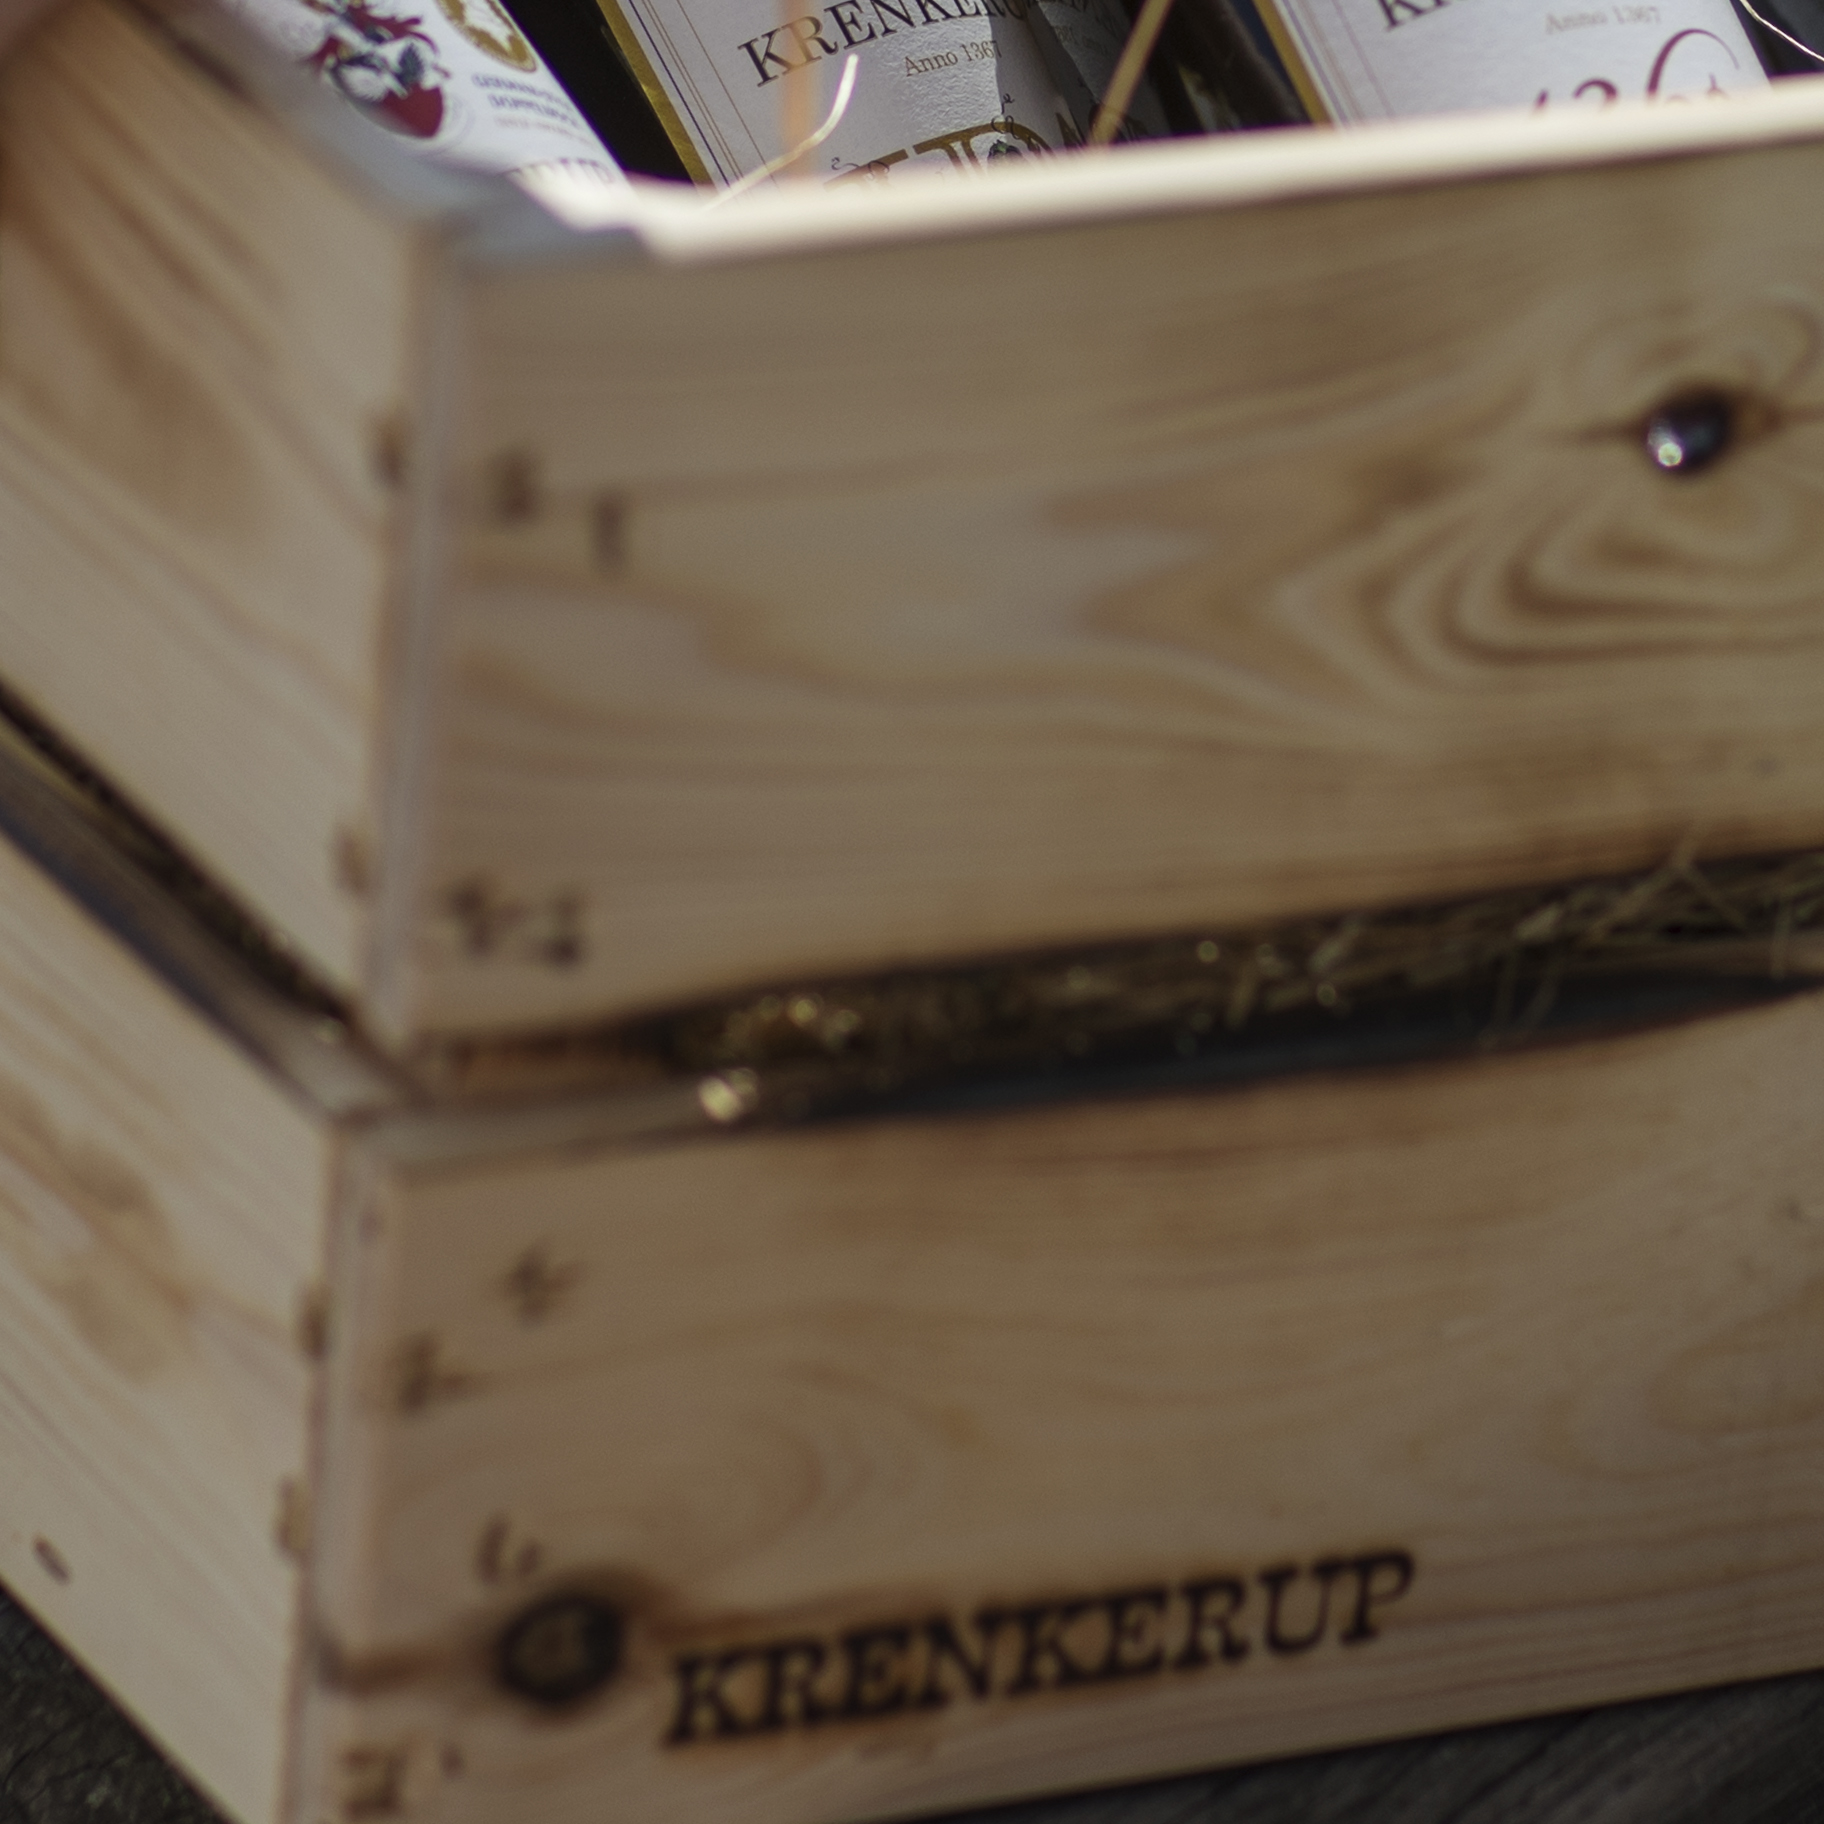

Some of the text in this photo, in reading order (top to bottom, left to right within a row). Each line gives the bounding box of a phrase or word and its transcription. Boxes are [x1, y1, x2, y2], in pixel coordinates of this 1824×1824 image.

[903, 40, 1003, 78] Anno 1367
[660, 1545, 1416, 1751] KRENKERUP
